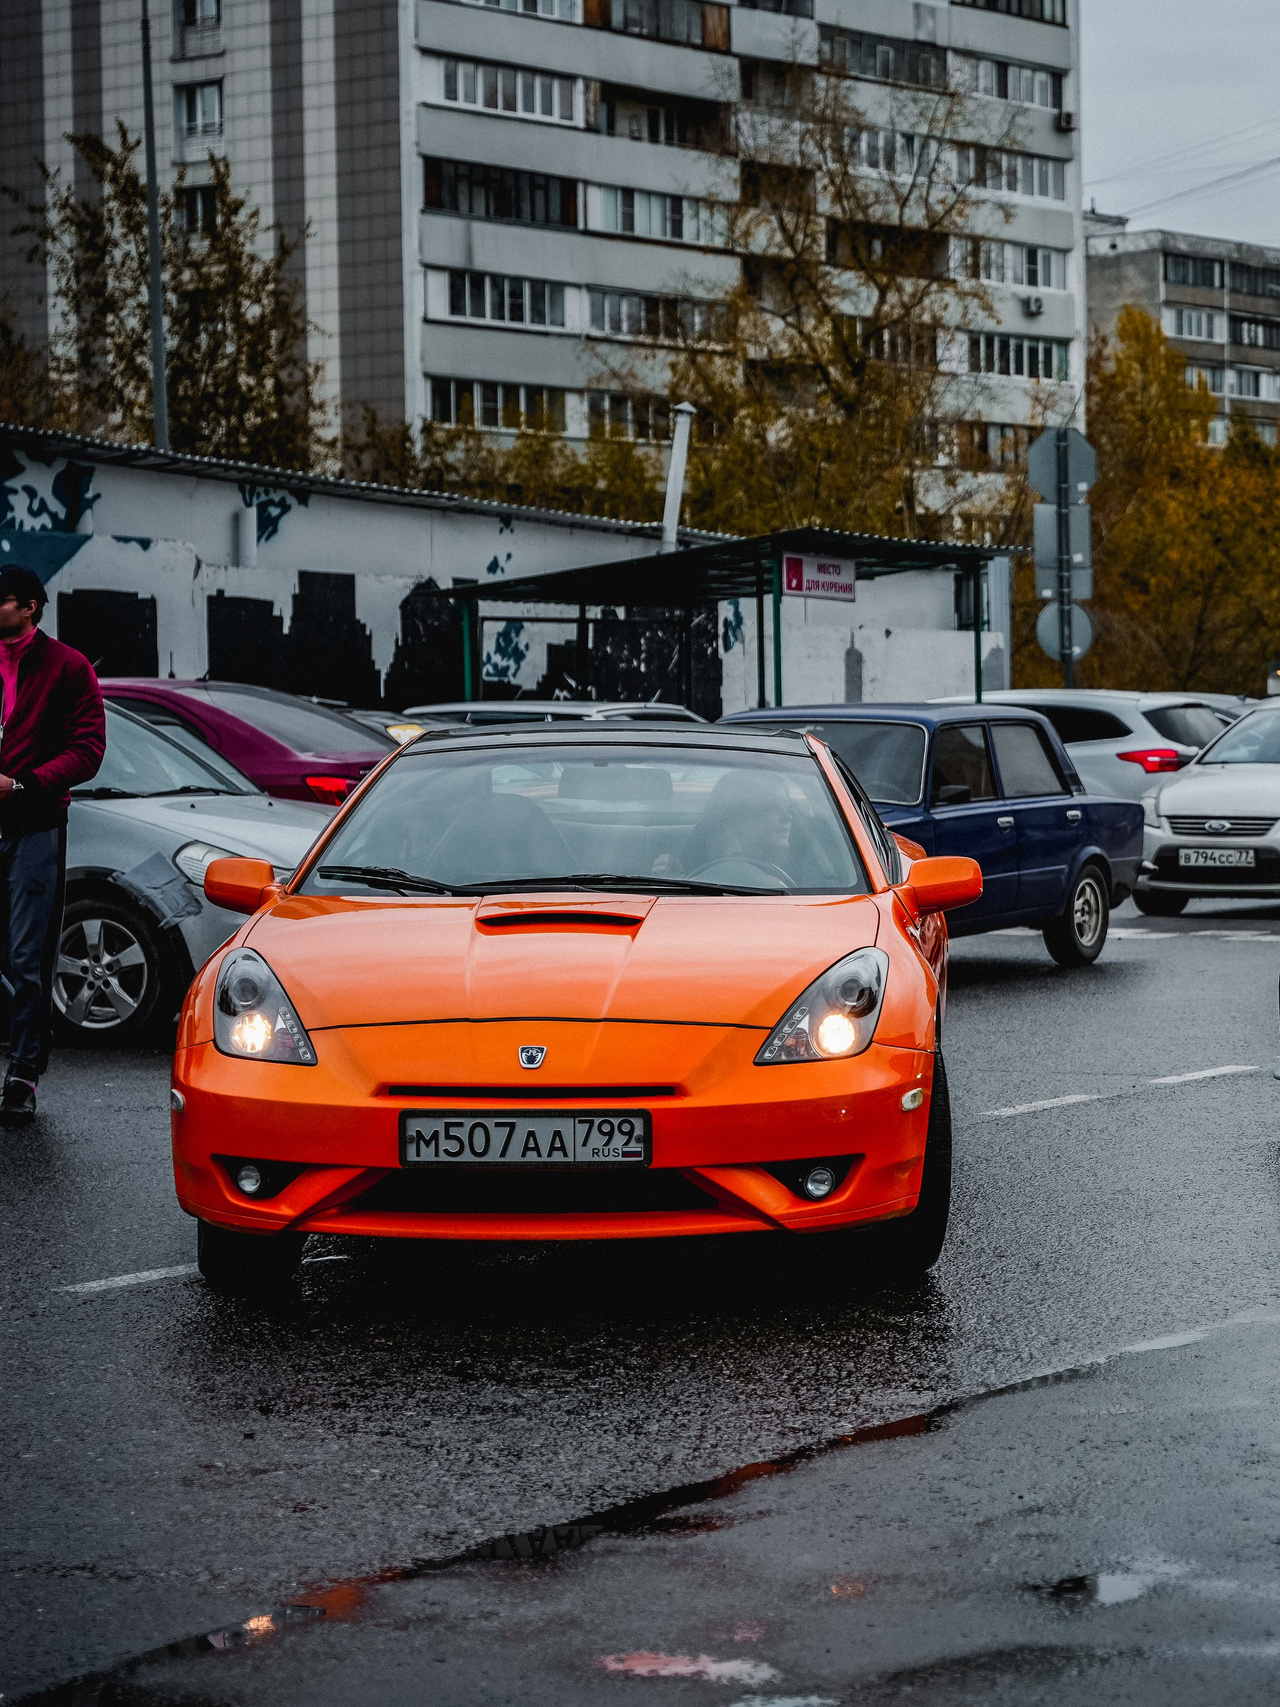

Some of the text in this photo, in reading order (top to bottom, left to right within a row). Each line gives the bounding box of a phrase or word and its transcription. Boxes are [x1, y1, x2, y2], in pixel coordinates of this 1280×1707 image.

[817, 563, 841, 575] МЕСТО
[806, 579, 853, 594] ДЛЯ КУРЕНИЯ
[415, 1118, 636, 1158] M507AA 799
[592, 1148, 620, 1158] RUS
